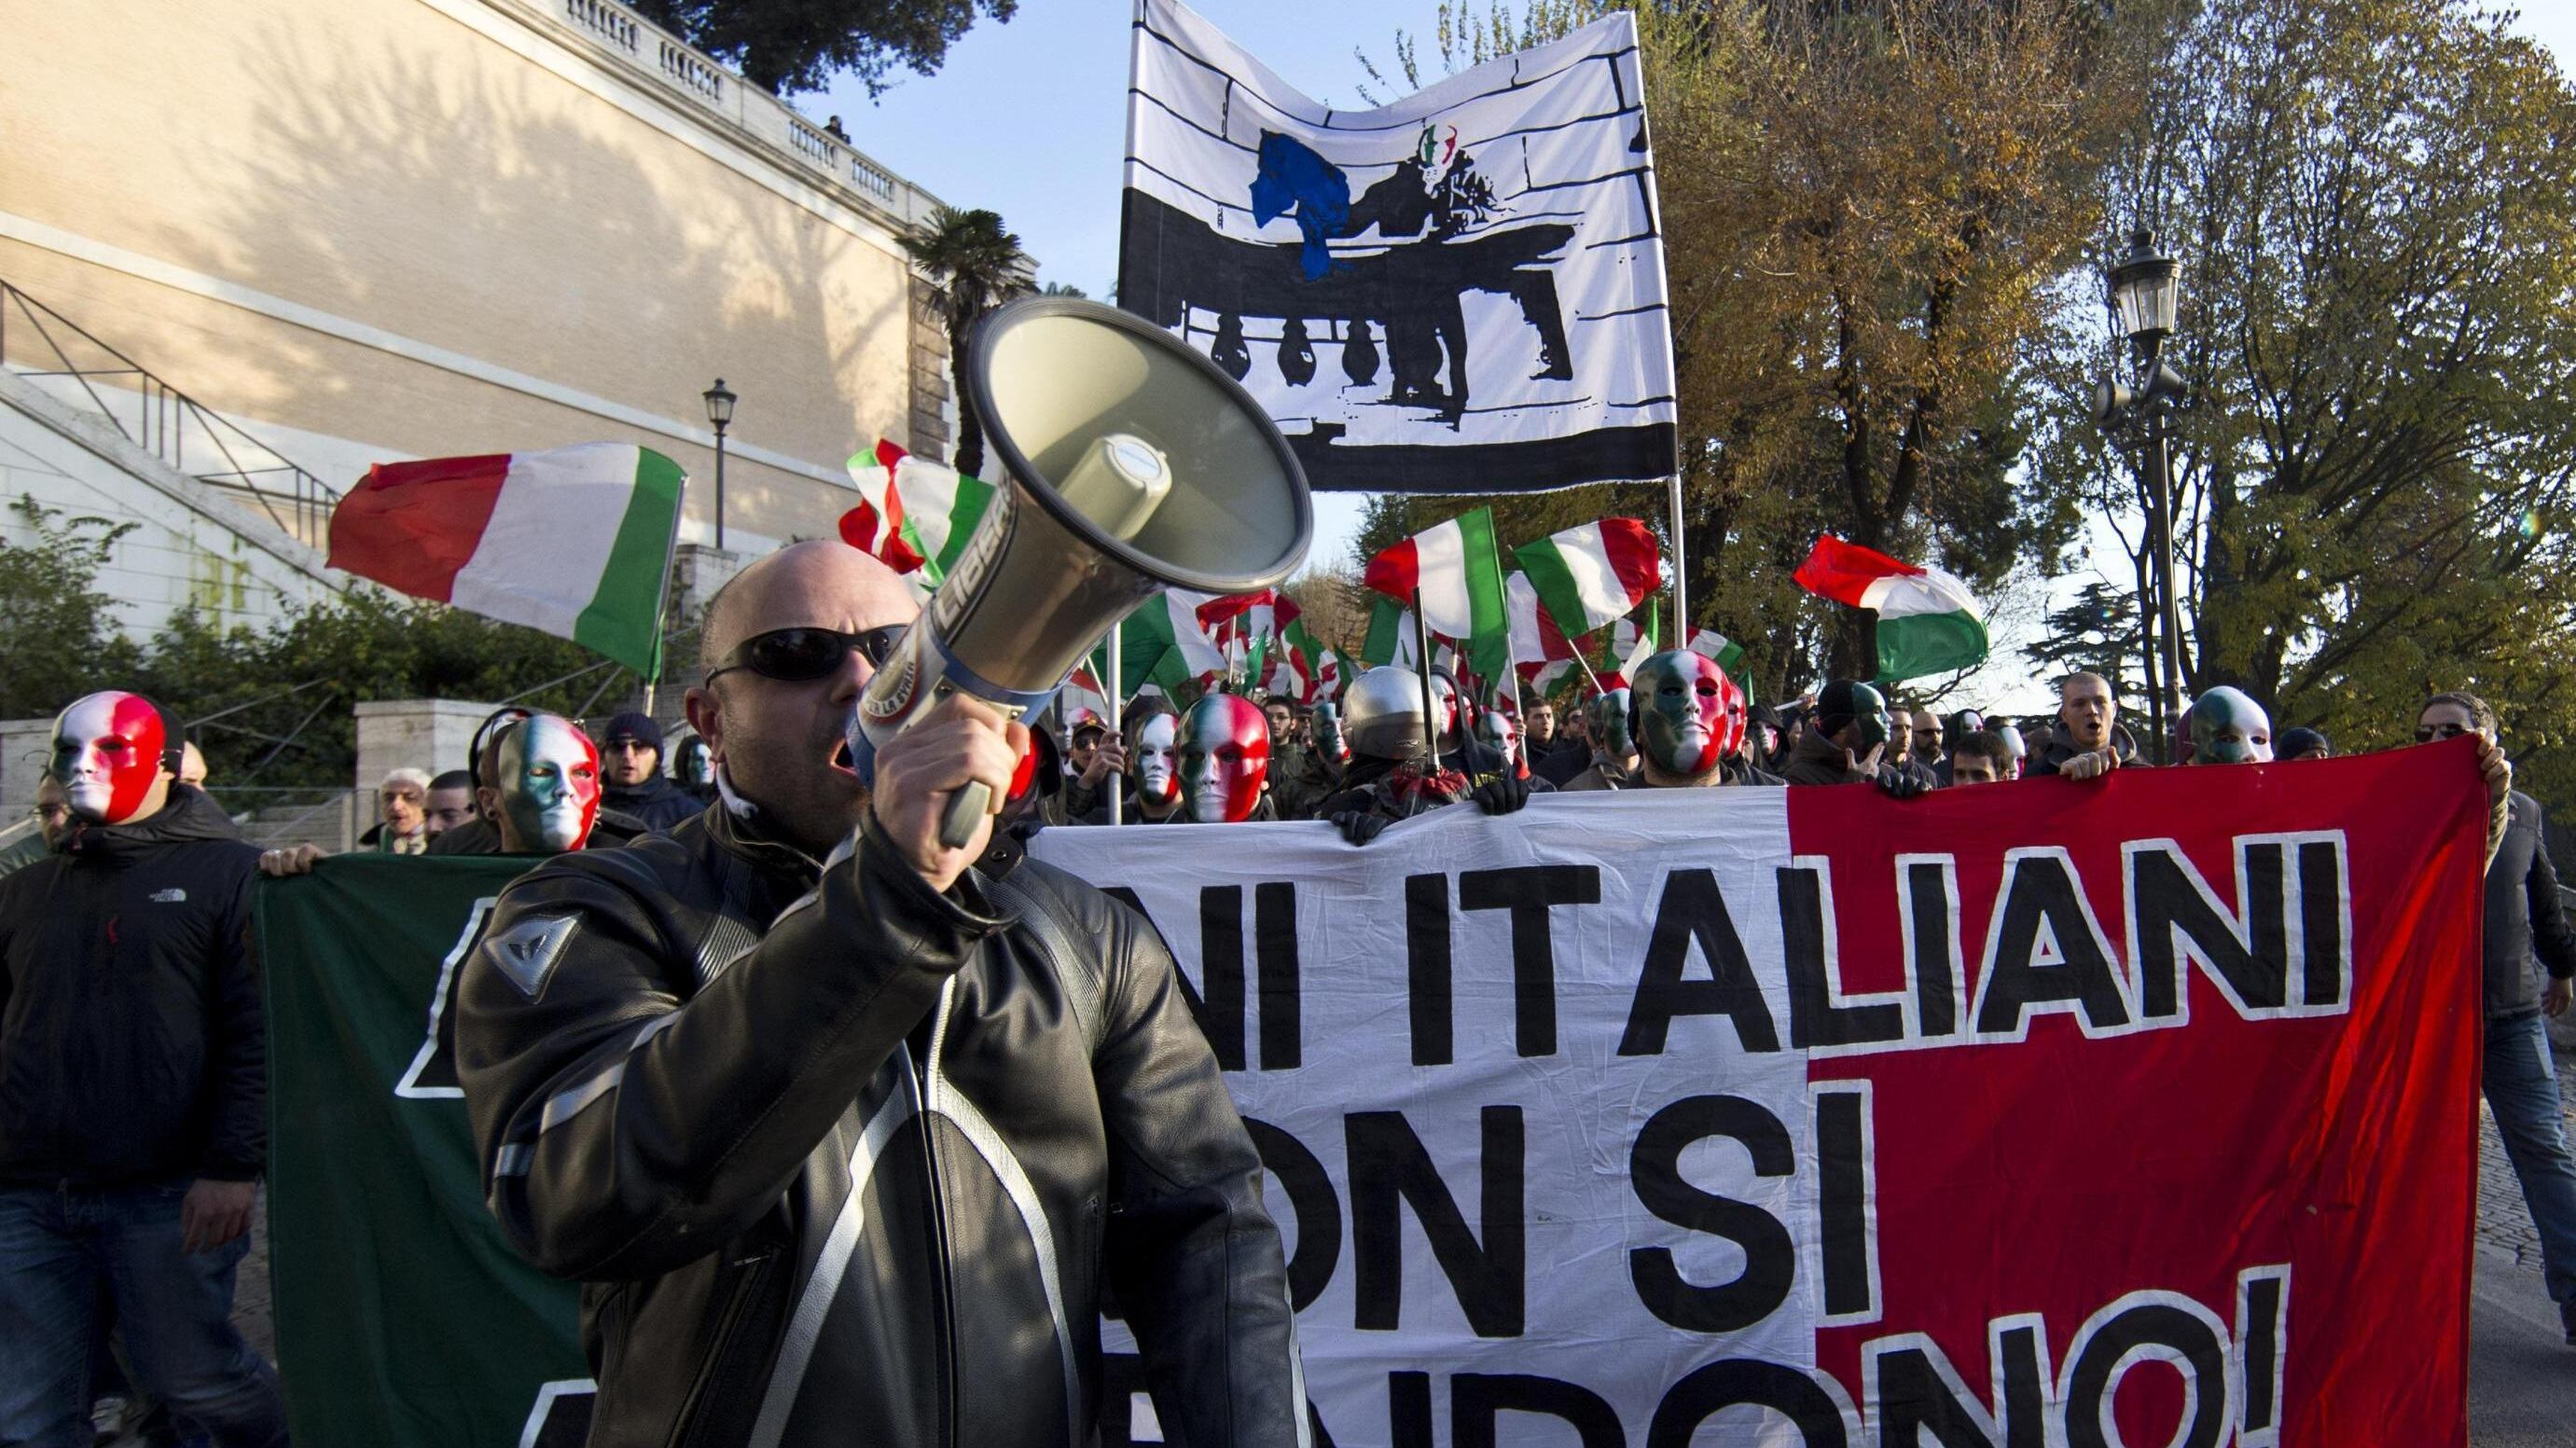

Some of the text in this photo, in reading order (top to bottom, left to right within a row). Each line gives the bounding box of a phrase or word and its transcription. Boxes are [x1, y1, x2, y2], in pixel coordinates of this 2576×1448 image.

[1098, 829, 2350, 1071] NI ITALIANI
[1629, 1079, 1882, 1332] SI
